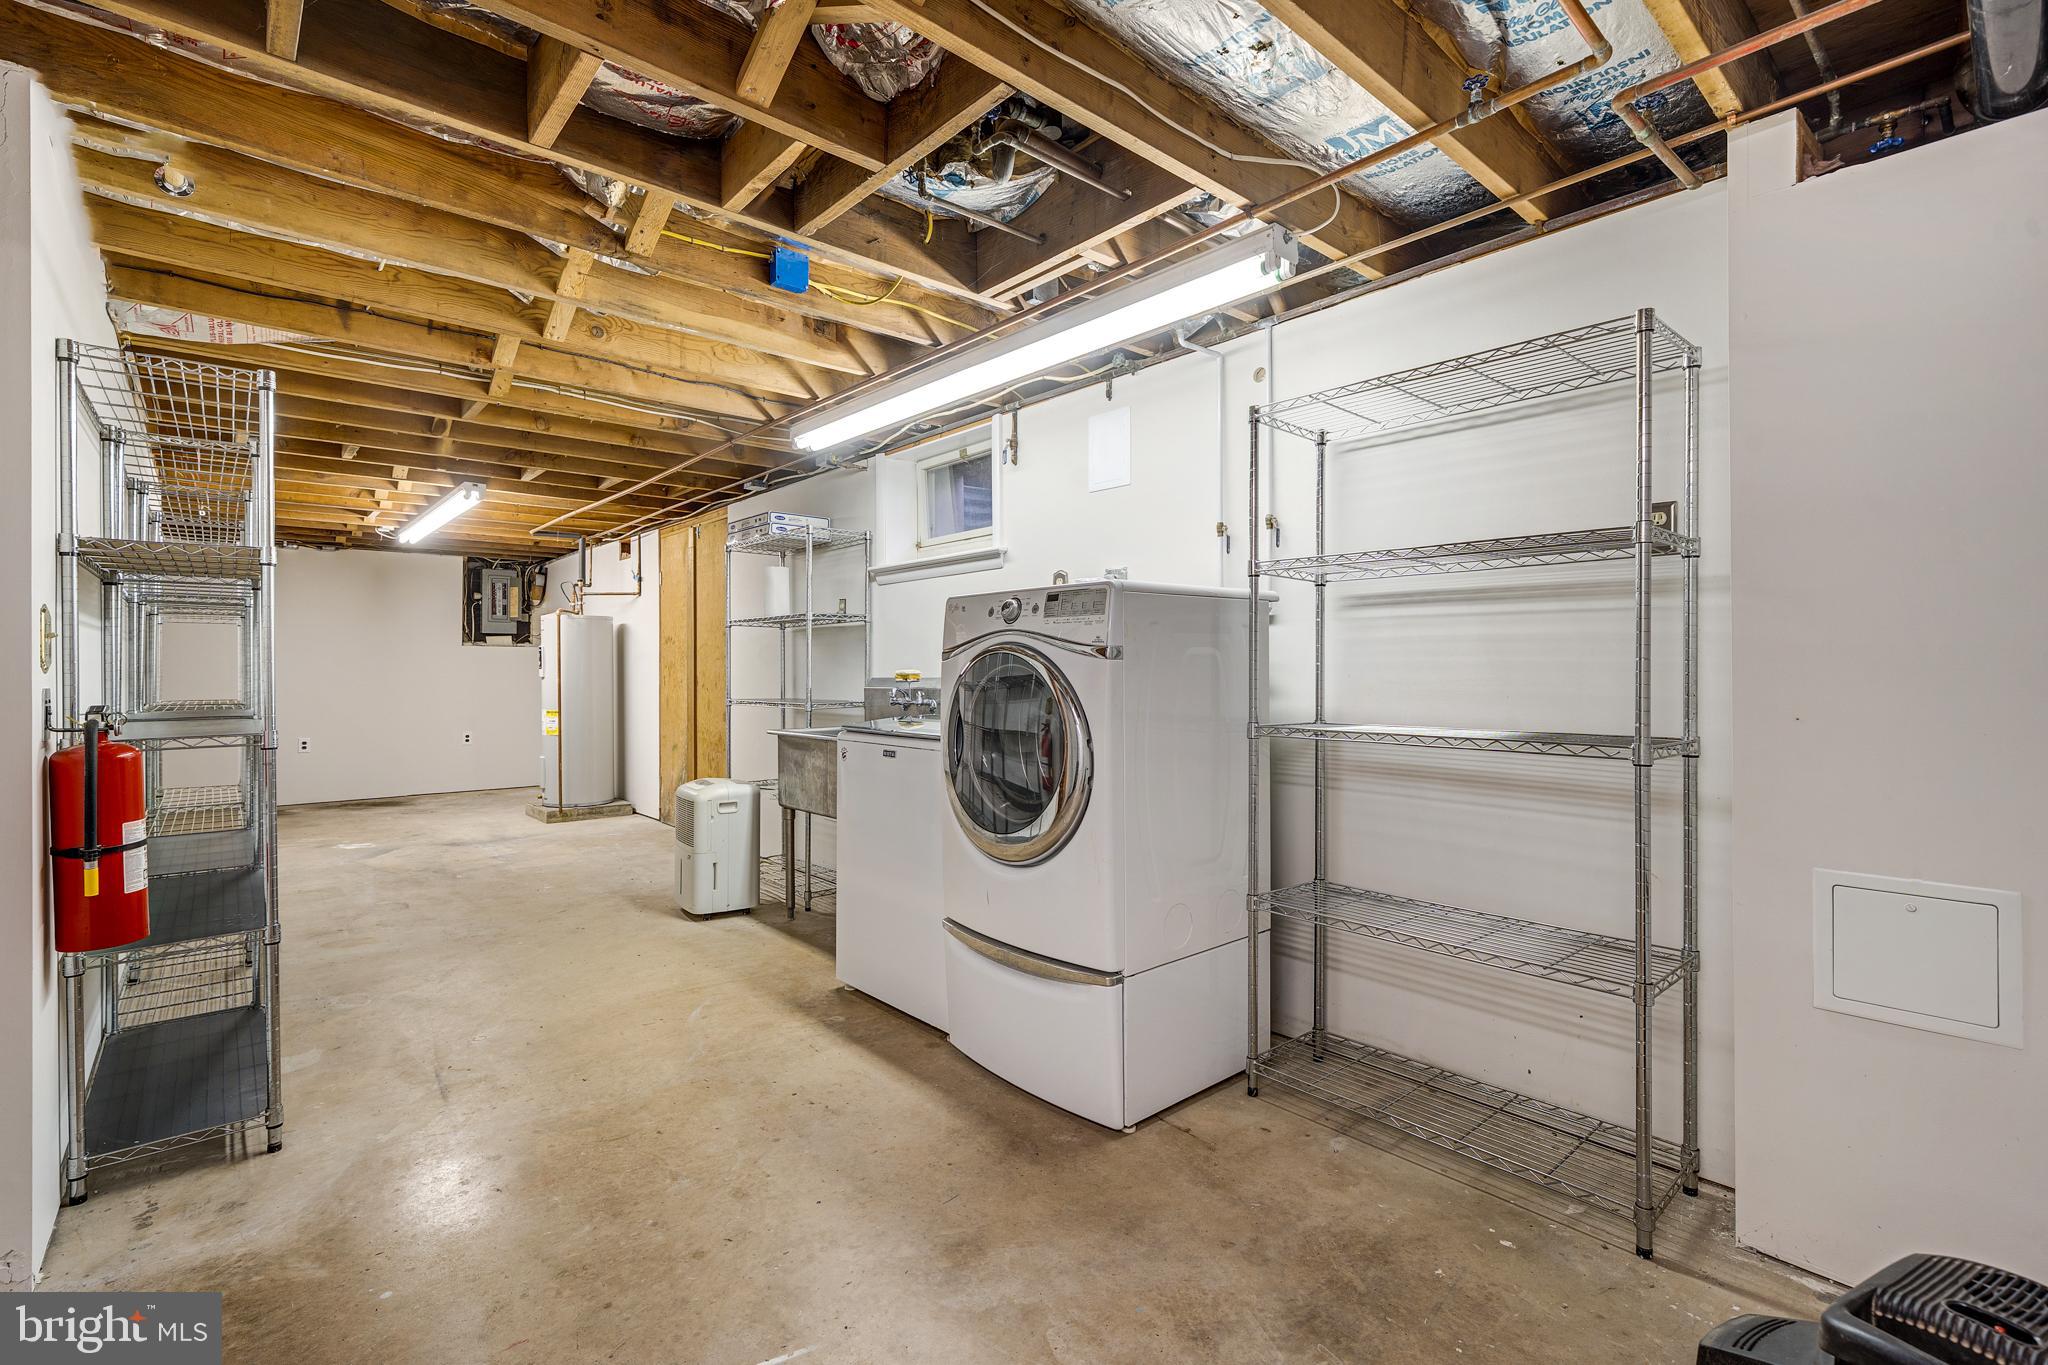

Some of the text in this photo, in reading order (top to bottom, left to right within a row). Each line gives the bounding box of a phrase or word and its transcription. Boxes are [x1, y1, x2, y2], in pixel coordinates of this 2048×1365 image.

[1512, 11, 1566, 37] HOM
[1540, 48, 1651, 98] INSULATION
[1569, 70, 1628, 95] HOME
[1374, 150, 1421, 170] HOME
